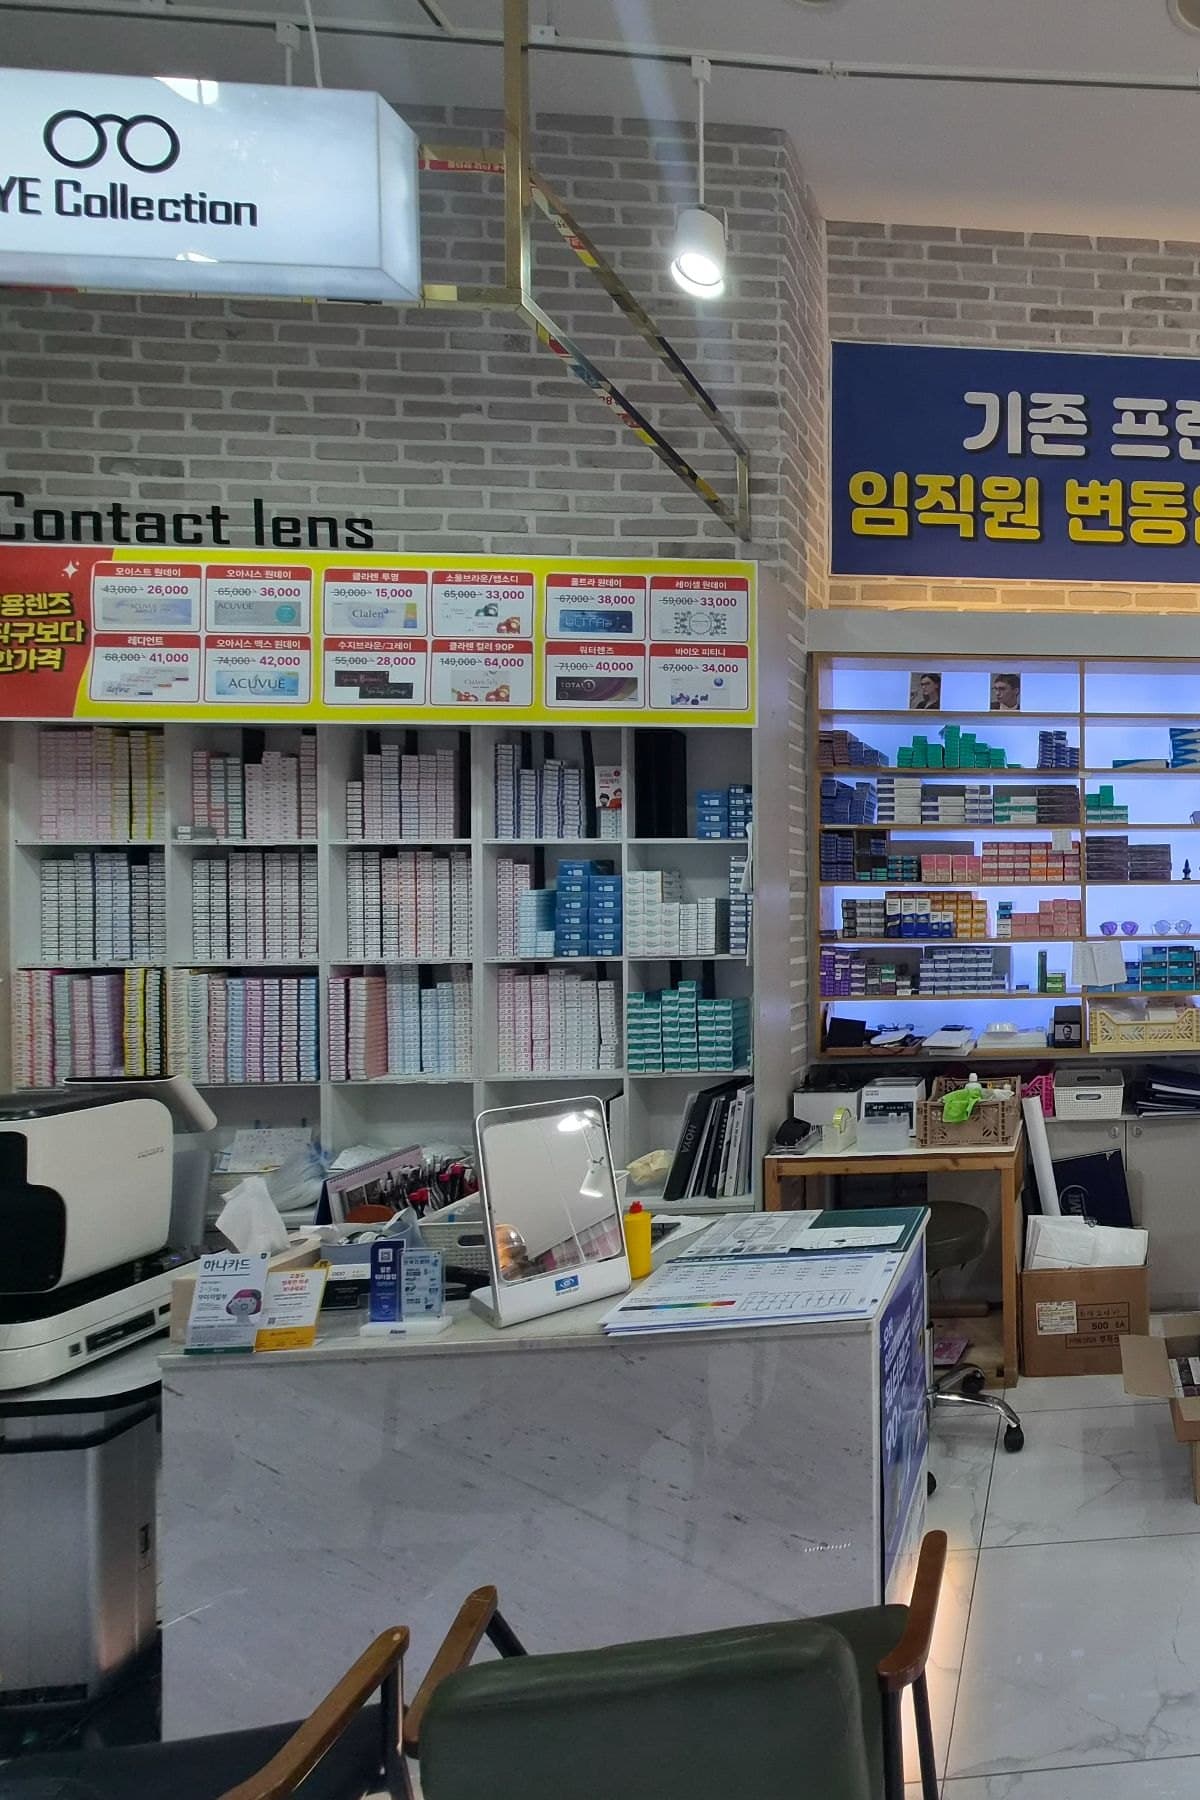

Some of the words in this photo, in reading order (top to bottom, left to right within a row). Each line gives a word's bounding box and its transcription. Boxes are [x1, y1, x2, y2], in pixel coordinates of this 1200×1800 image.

[0, 176, 42, 215] YE
[54, 179, 258, 227] Collection
[963, 391, 1088, 456] 기존
[848, 471, 1042, 541] 임직원
[0, 491, 230, 545] Contact
[254, 498, 374, 549] lens
[115, 567, 152, 577] 모이스트
[154, 567, 182, 577] 원데이
[226, 569, 263, 578] 오아시스
[265, 569, 292, 579] 원데이
[147, 585, 189, 596] 26,000
[259, 587, 300, 598] 36,000
[375, 588, 413, 599] 15,000
[486, 590, 525, 600] 33,000
[597, 595, 635, 606] 38,000
[700, 597, 737, 607] 33,000
[216, 639, 253, 649] 오아시스
[149, 653, 189, 664] 41,000
[259, 656, 300, 667] 42,000
[376, 656, 416, 668] 28,000
[484, 658, 524, 669] 64,000
[595, 662, 633, 673] 40,000
[228, 677, 286, 689] ACUVUE
[204, 1259, 250, 1271] 하나카드
